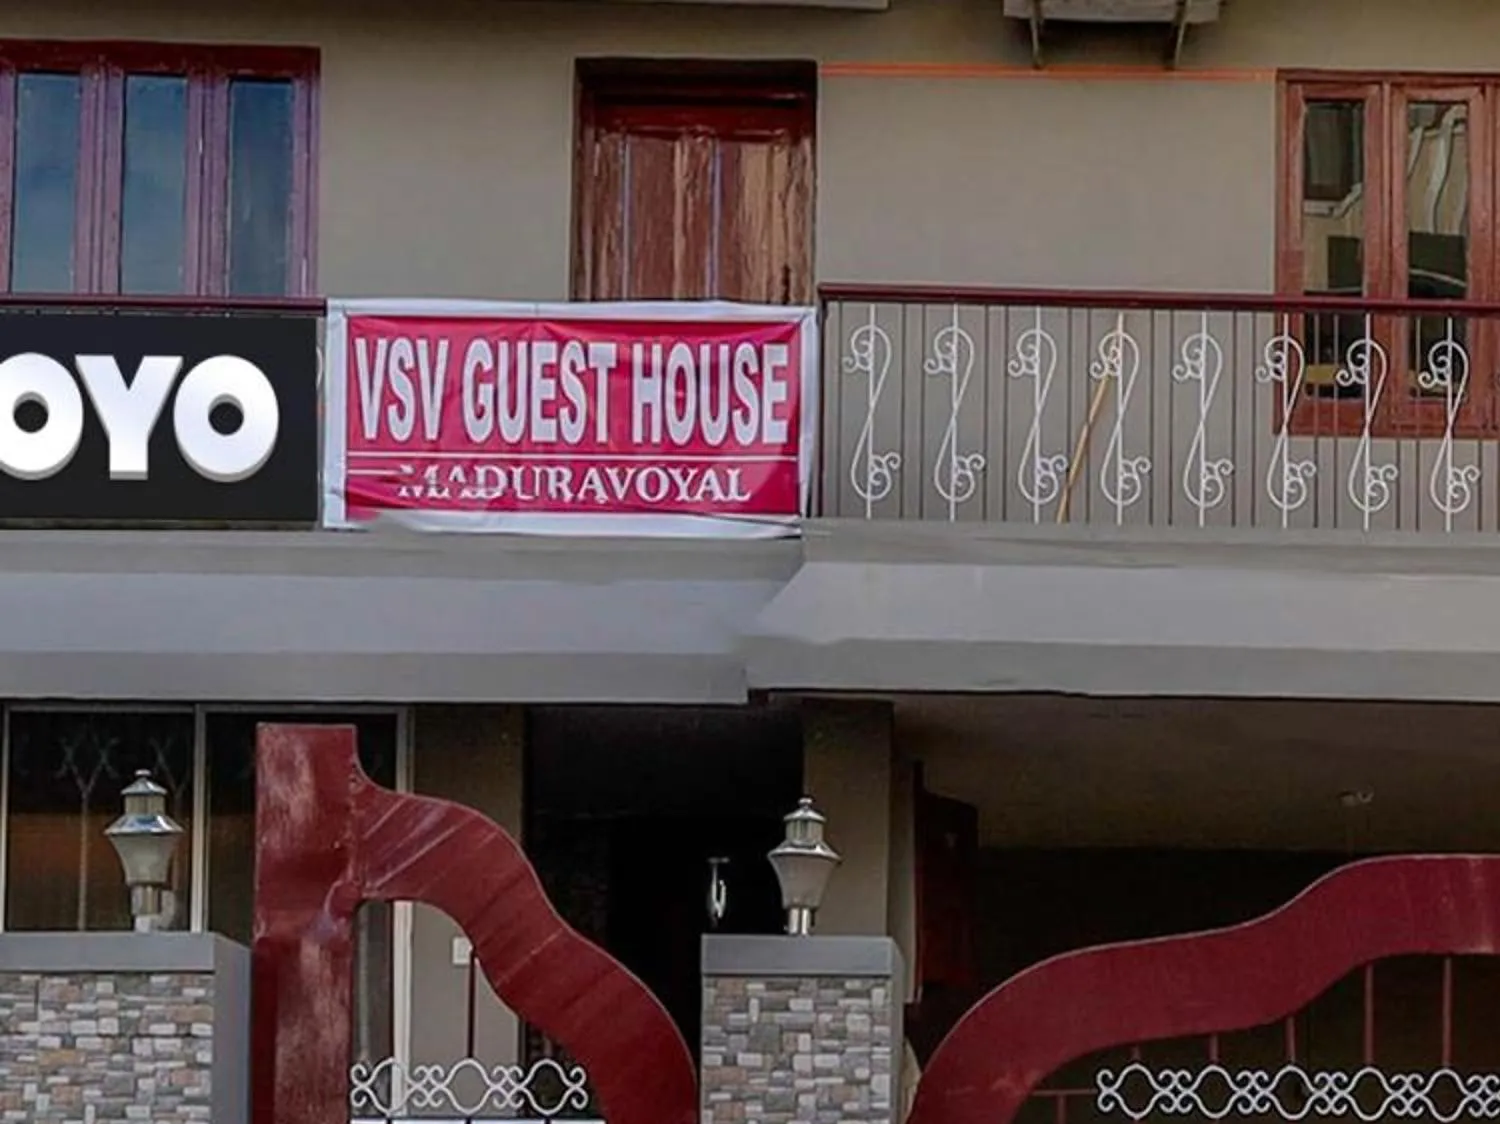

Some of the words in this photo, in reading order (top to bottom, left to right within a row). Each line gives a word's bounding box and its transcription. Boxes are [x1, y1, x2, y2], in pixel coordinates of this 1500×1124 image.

[0, 352, 279, 482] OYO
[354, 337, 450, 442] VSV
[462, 338, 617, 444] GUEST
[631, 342, 788, 445] HOUSE
